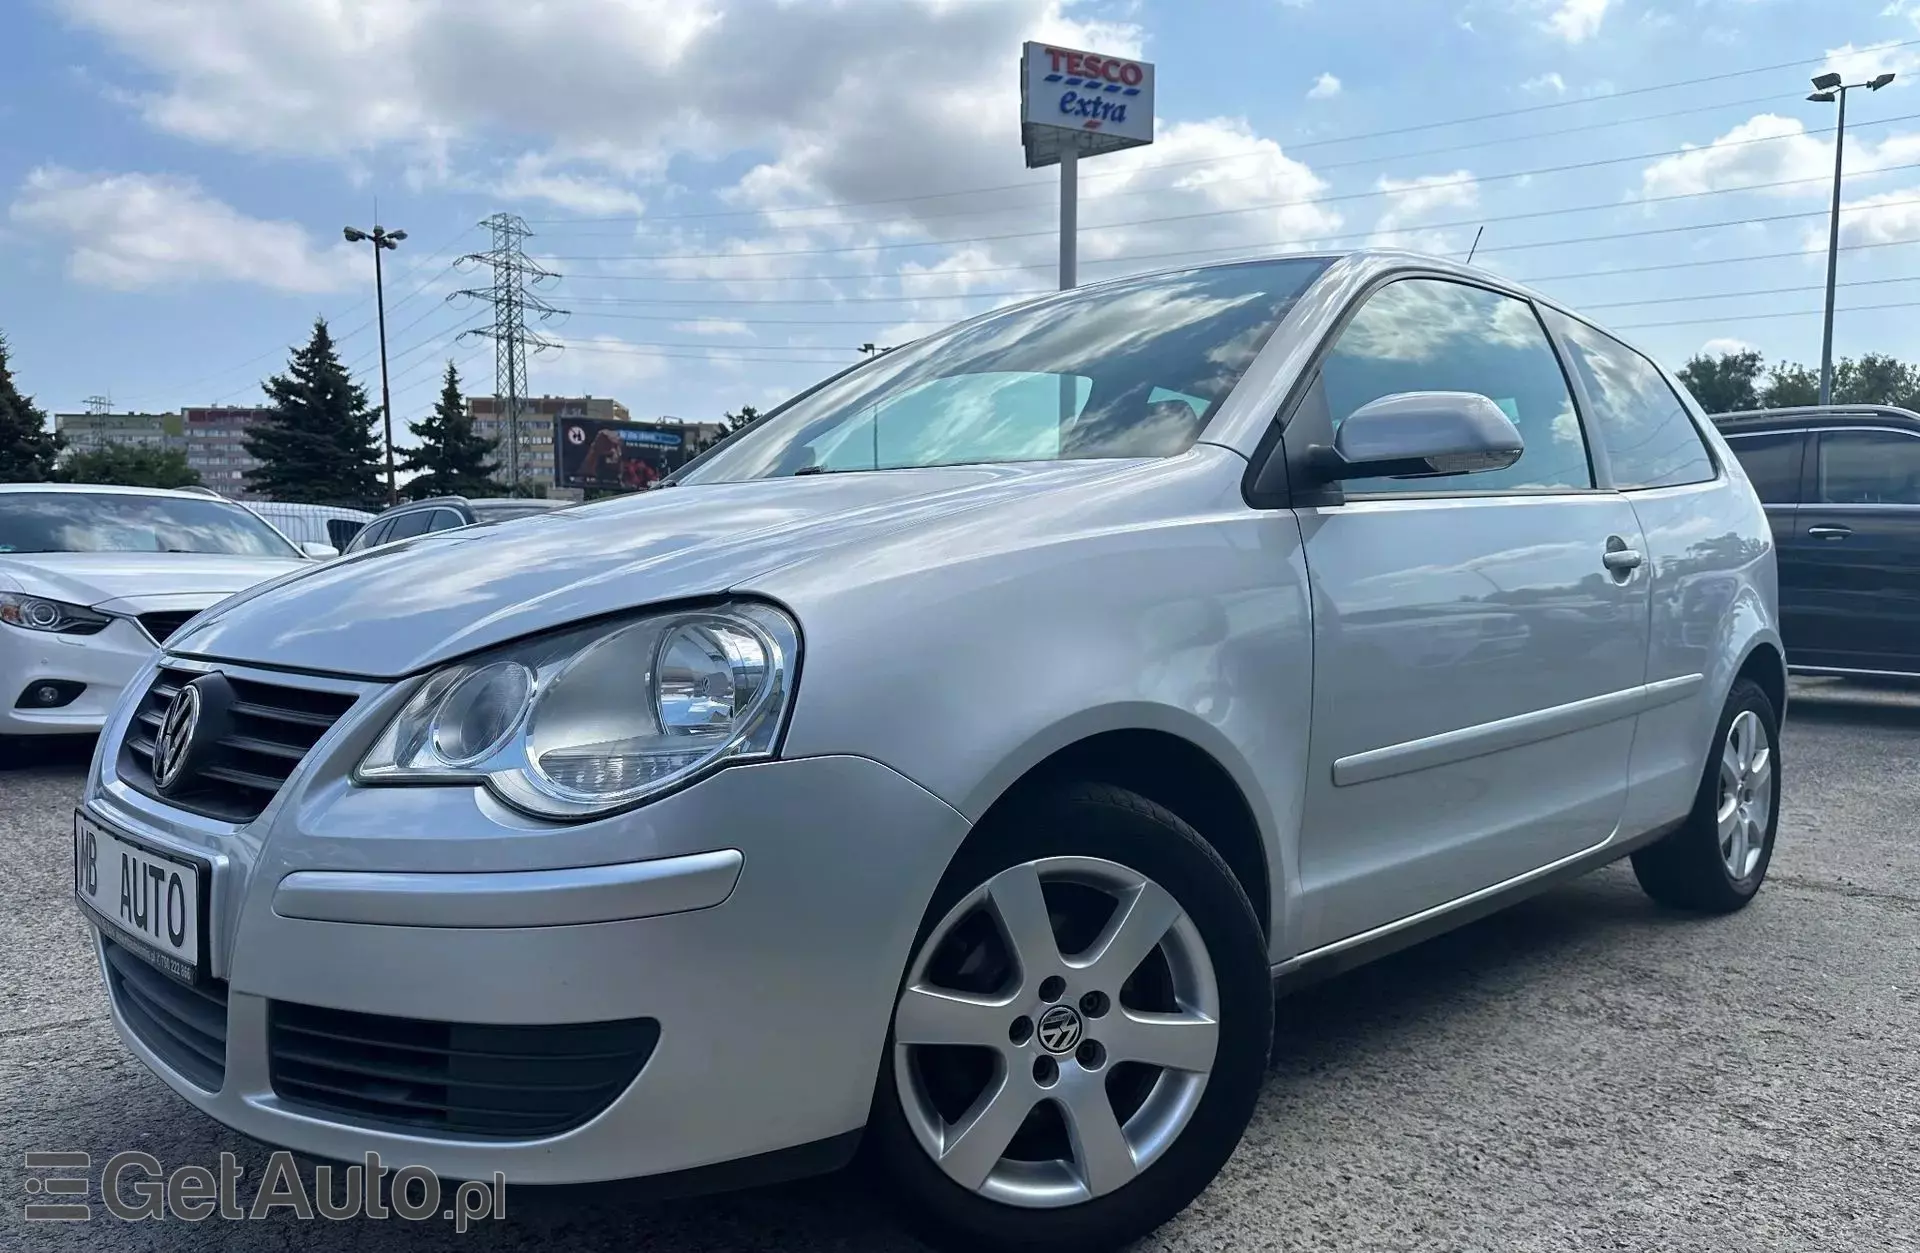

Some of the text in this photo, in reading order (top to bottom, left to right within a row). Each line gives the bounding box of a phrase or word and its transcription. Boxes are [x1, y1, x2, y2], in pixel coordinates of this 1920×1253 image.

[1044, 48, 1143, 86] TESCO
[1059, 91, 1128, 123] extra
[120, 853, 185, 948] AUTO
